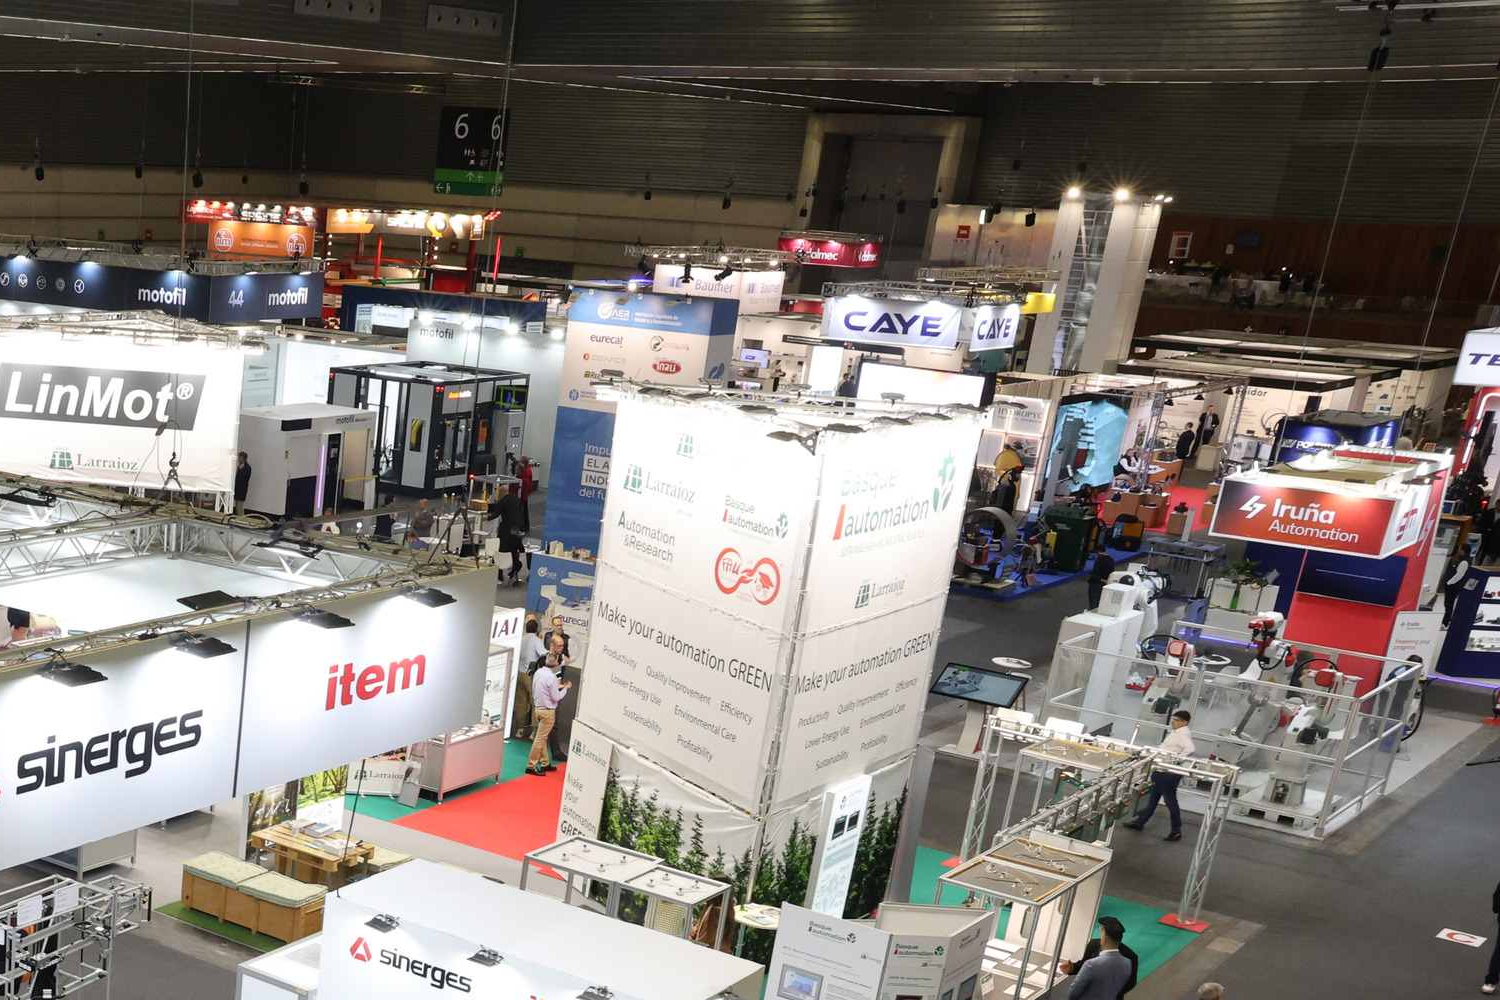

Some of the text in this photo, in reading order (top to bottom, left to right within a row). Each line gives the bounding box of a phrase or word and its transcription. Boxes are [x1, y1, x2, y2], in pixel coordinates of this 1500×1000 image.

[454, 113, 469, 139] 6
[491, 114, 501, 141] 6
[137, 286, 186, 306] motofil
[228, 290, 245, 307] 44
[268, 287, 309, 306] motofil
[694, 278, 735, 294] Baumer
[760, 281, 781, 294] Baumer
[419, 327, 454, 339] motofil
[843, 310, 943, 338] CAYE
[976, 317, 1013, 340] CAYE
[76, 452, 138, 471] Larraioz
[586, 457, 600, 469] EL
[578, 487, 595, 499] del
[644, 471, 696, 505] Larraioz
[724, 494, 756, 515] Basque
[843, 496, 930, 538] automation
[1271, 498, 1336, 525] Iruña
[617, 510, 676, 547] Automation
[727, 512, 775, 538] automation
[1268, 520, 1360, 544] Automation
[623, 534, 674, 564] &Research
[871, 576, 906, 598] Larraioz
[597, 600, 773, 693] Make your automation GREEN
[795, 631, 935, 697] Make your automation GREEN
[324, 654, 427, 711] item
[602, 644, 754, 726] Productivity Quality Improvement Efficiency
[610, 672, 737, 744] Lower Energy Use Environmental Care
[797, 676, 919, 729] Productivity Quality Improvement Efficiency
[622, 705, 663, 736] Sustainability
[804, 703, 906, 750] Lower Energy Use Environmental Care
[15, 709, 204, 796] sinerges
[676, 734, 714, 763] Profitability
[859, 733, 888, 752] Profitability
[582, 743, 607, 768] Larraioz
[815, 749, 850, 771] Sustainability
[369, 769, 405, 780] Larraioz
[567, 772, 584, 792] Make
[564, 789, 579, 804] your
[560, 820, 588, 837] GRE
[562, 803, 597, 835] automation
[812, 928, 847, 943] automation
[379, 947, 473, 993] sinerges
